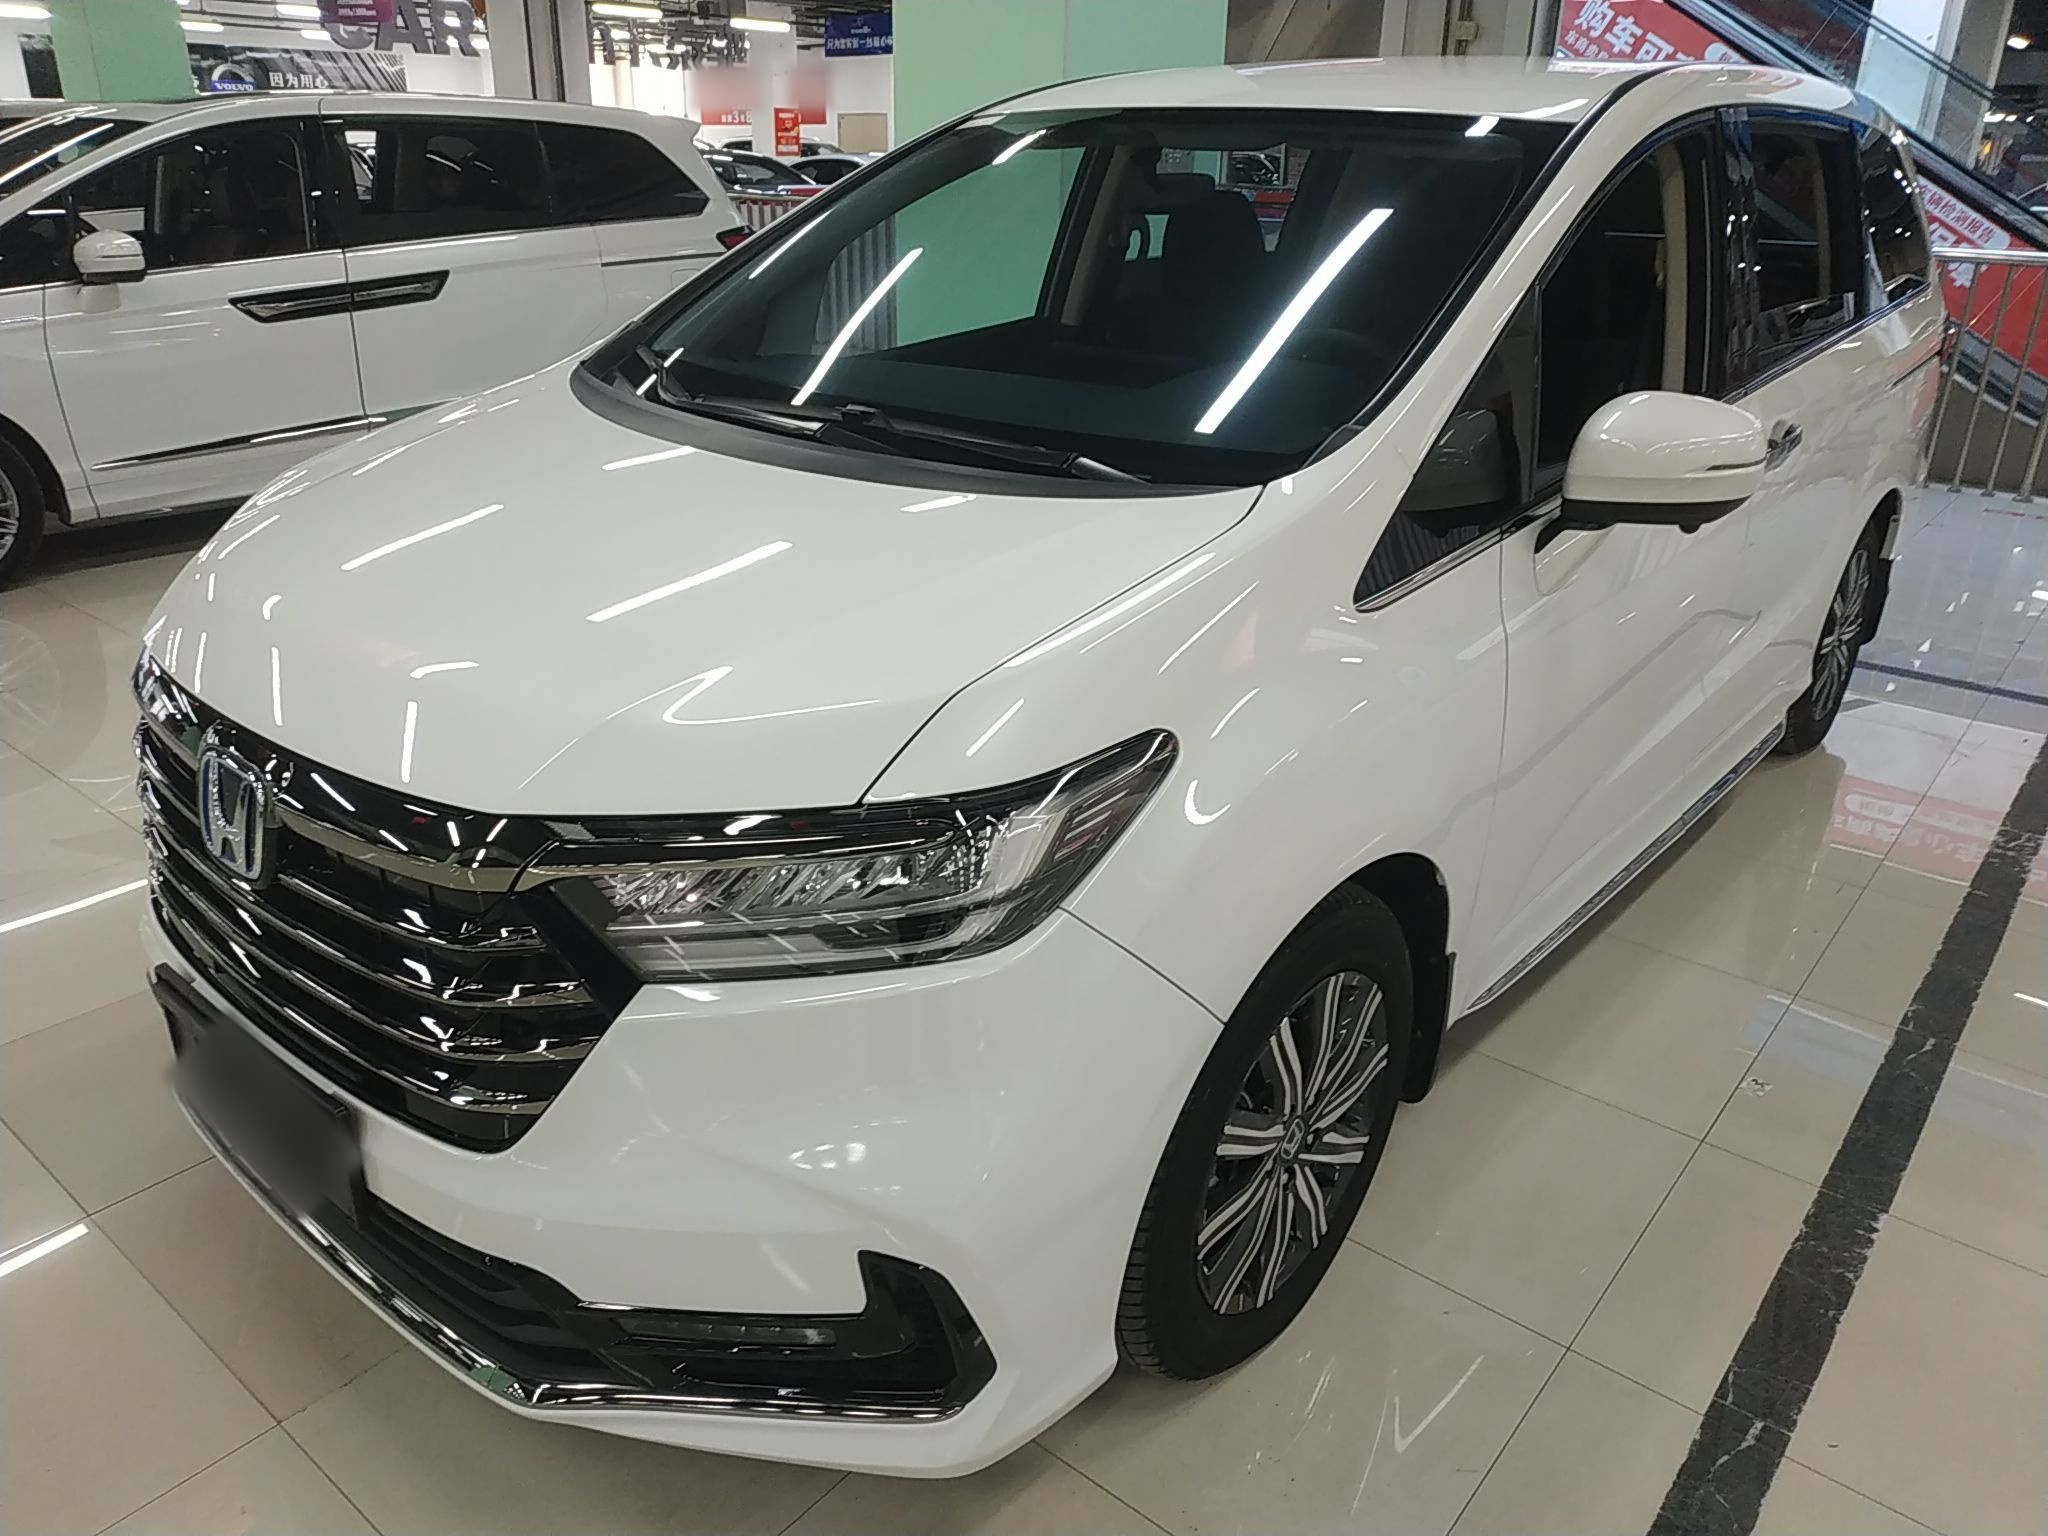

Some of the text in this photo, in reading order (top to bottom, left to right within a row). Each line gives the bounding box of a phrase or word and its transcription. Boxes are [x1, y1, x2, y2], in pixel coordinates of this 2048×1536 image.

[1574, 0, 1695, 62] 购车可
[213, 81, 254, 92] VOLVO
[269, 71, 329, 88] 因为用心
